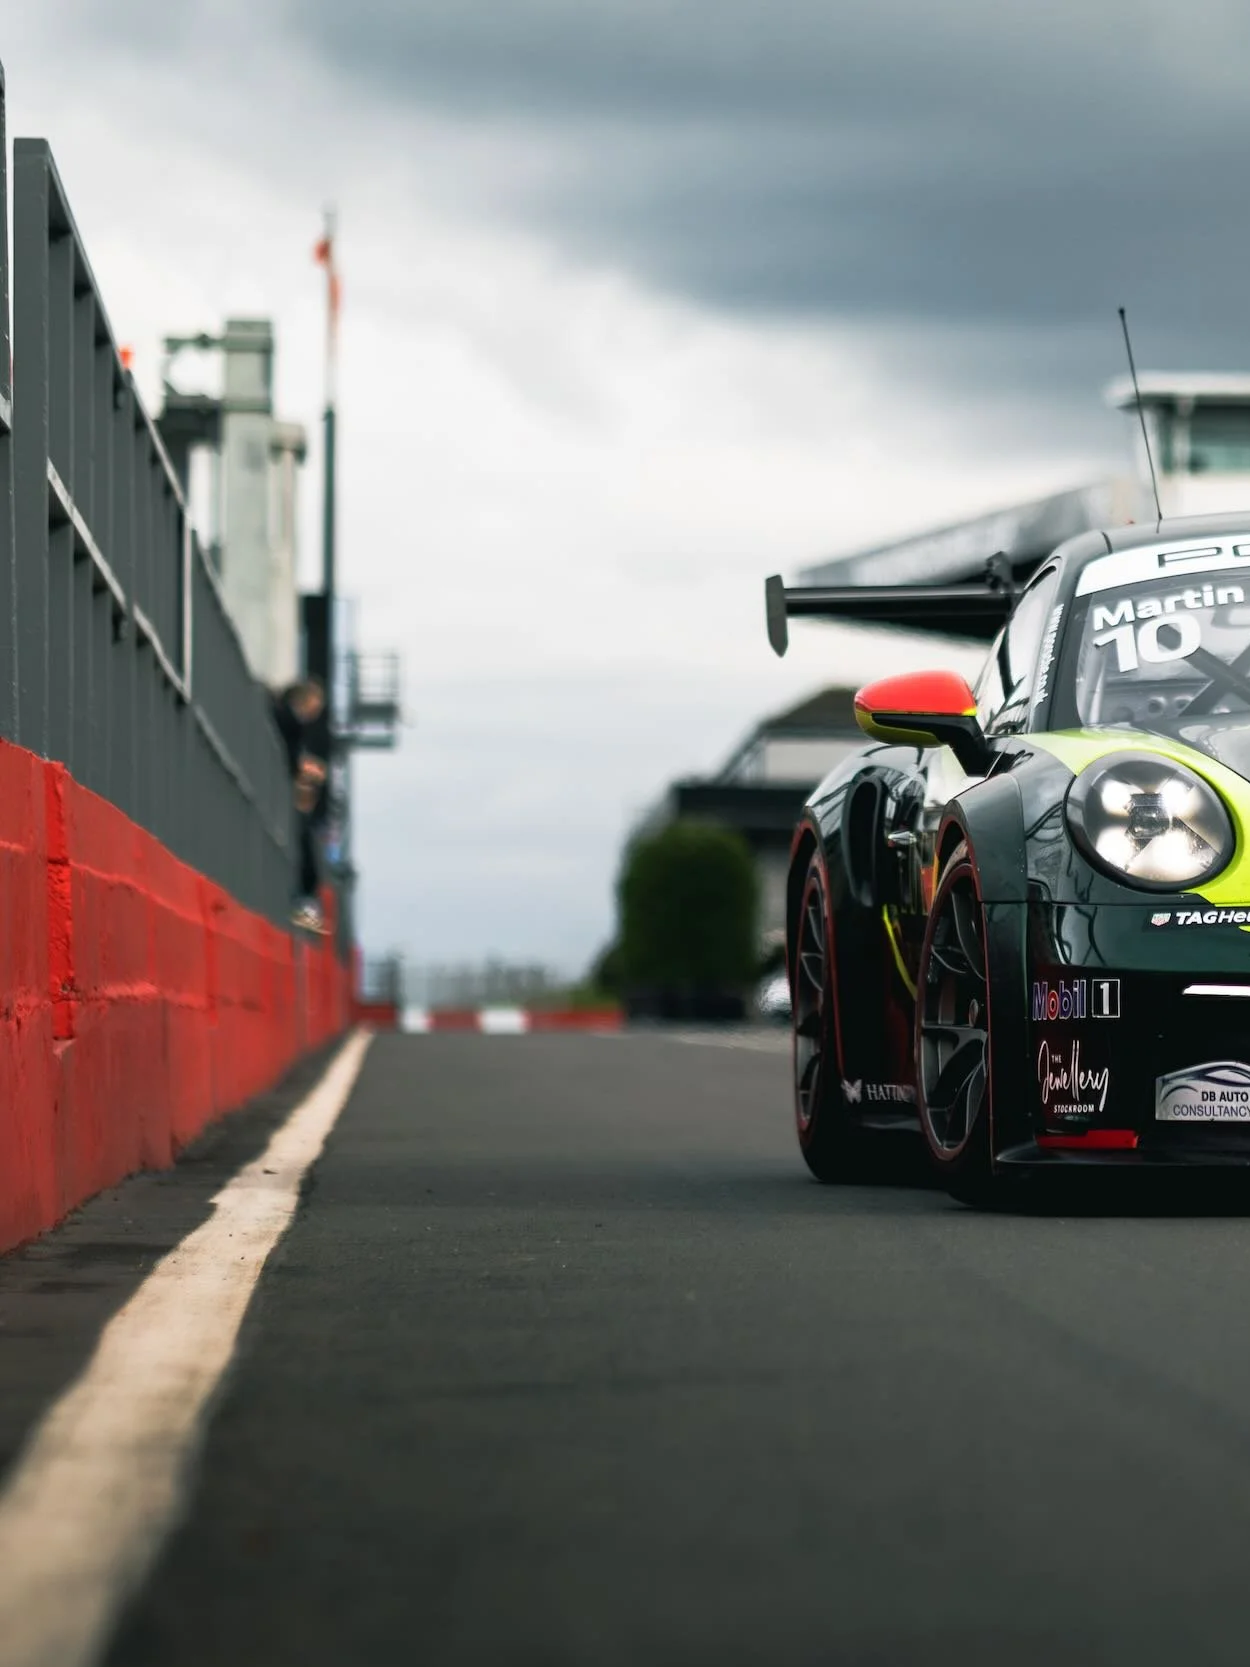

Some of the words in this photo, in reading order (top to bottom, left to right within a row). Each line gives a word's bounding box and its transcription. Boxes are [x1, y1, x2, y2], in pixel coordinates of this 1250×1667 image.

[1093, 584, 1245, 631] Martin
[1093, 613, 1202, 673] 10
[1033, 979, 1087, 1021] Mobil
[1037, 1039, 1109, 1113] Jewellery
[1051, 1054, 1062, 1064] THE
[1053, 1103, 1095, 1114] STOCKROOM
[1201, 1091, 1216, 1102] DB
[1219, 1090, 1249, 1103] AUTO
